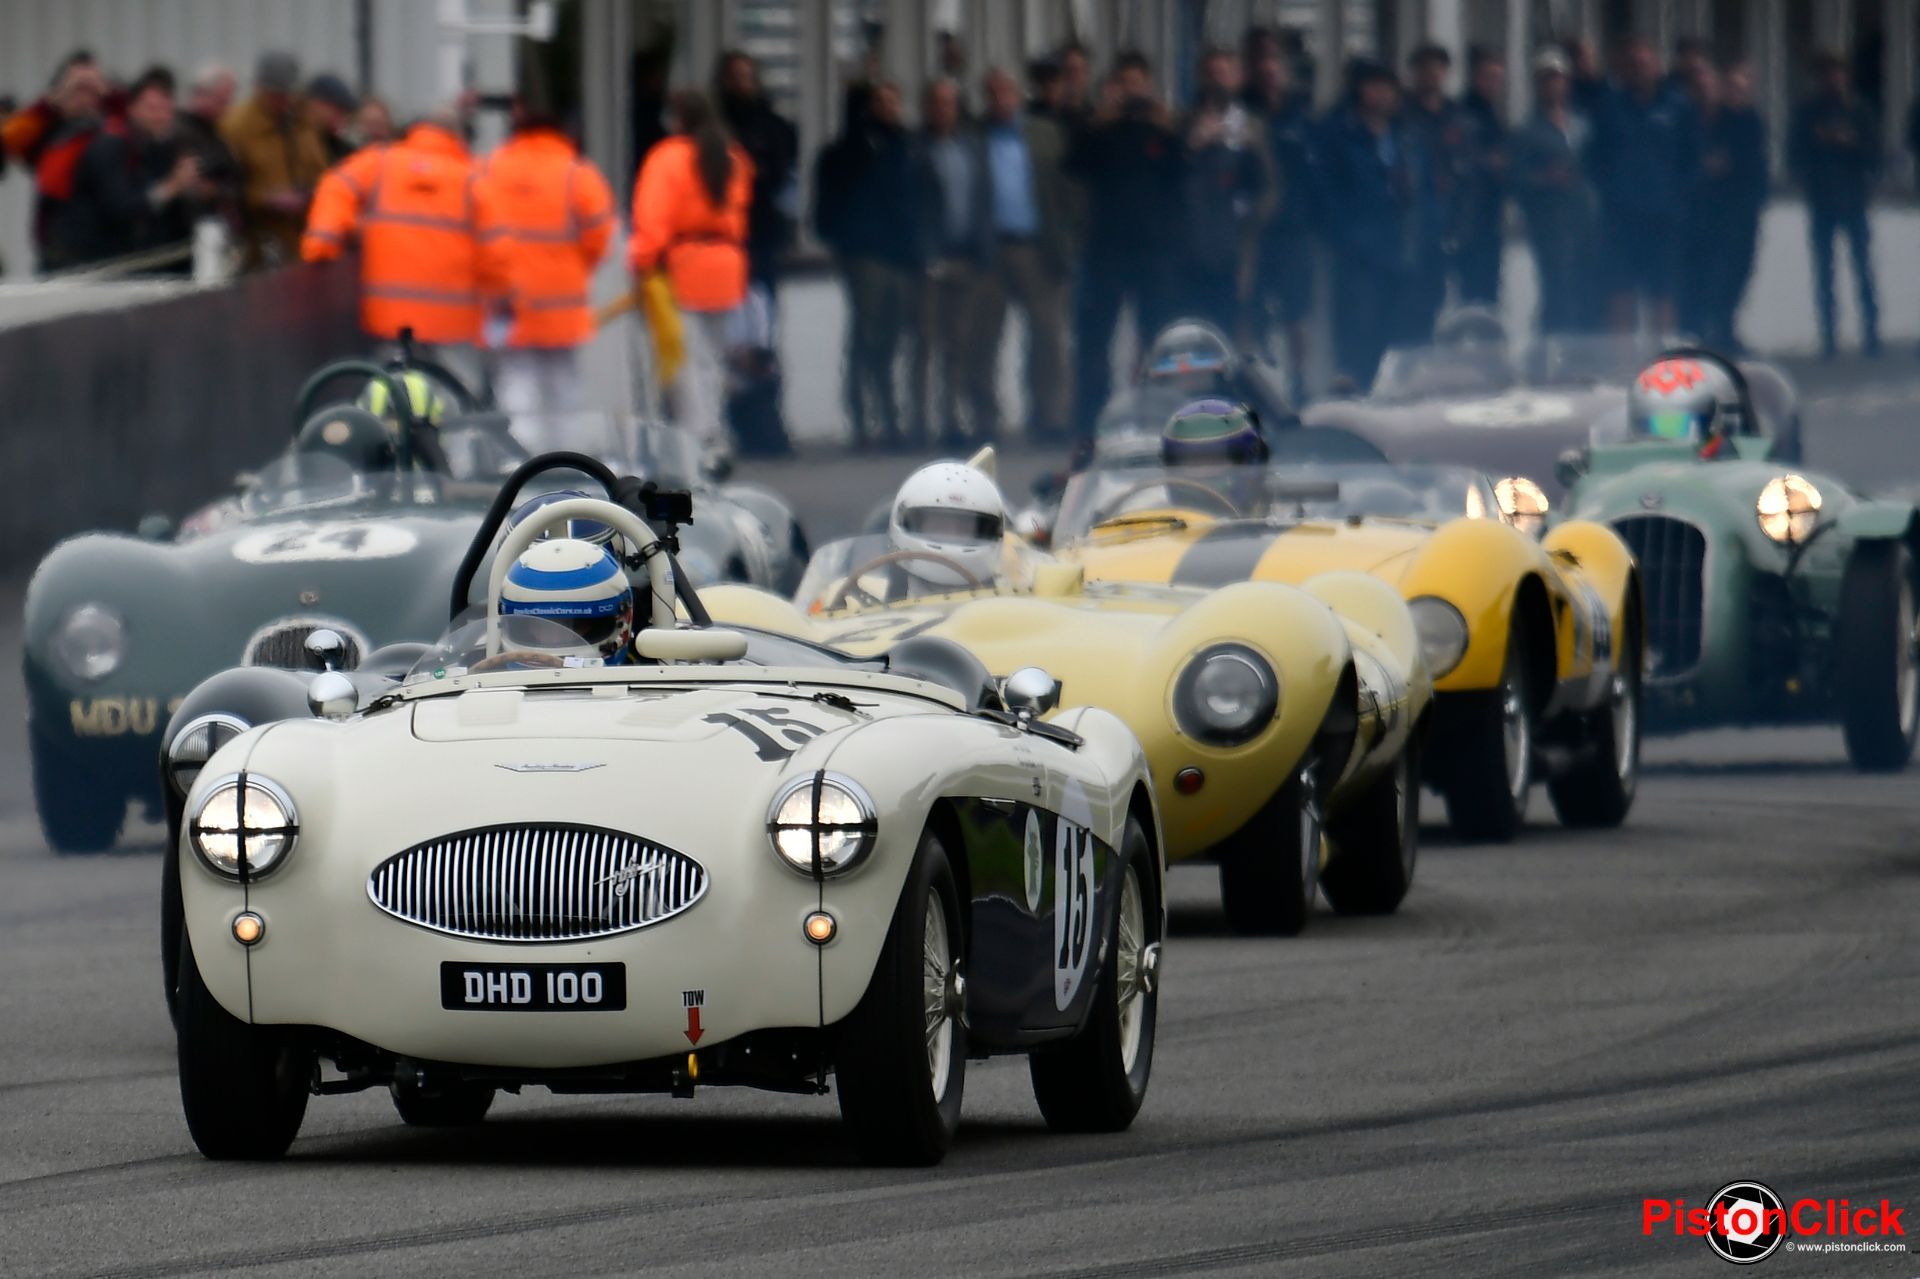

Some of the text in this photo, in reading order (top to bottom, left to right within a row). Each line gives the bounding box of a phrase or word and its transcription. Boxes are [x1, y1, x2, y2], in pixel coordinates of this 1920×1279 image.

[70, 698, 157, 736] MDU
[700, 707, 827, 762] 15
[1058, 826, 1091, 970] 15
[463, 972, 603, 1004] DHD 100
[682, 989, 705, 1007] TOW
